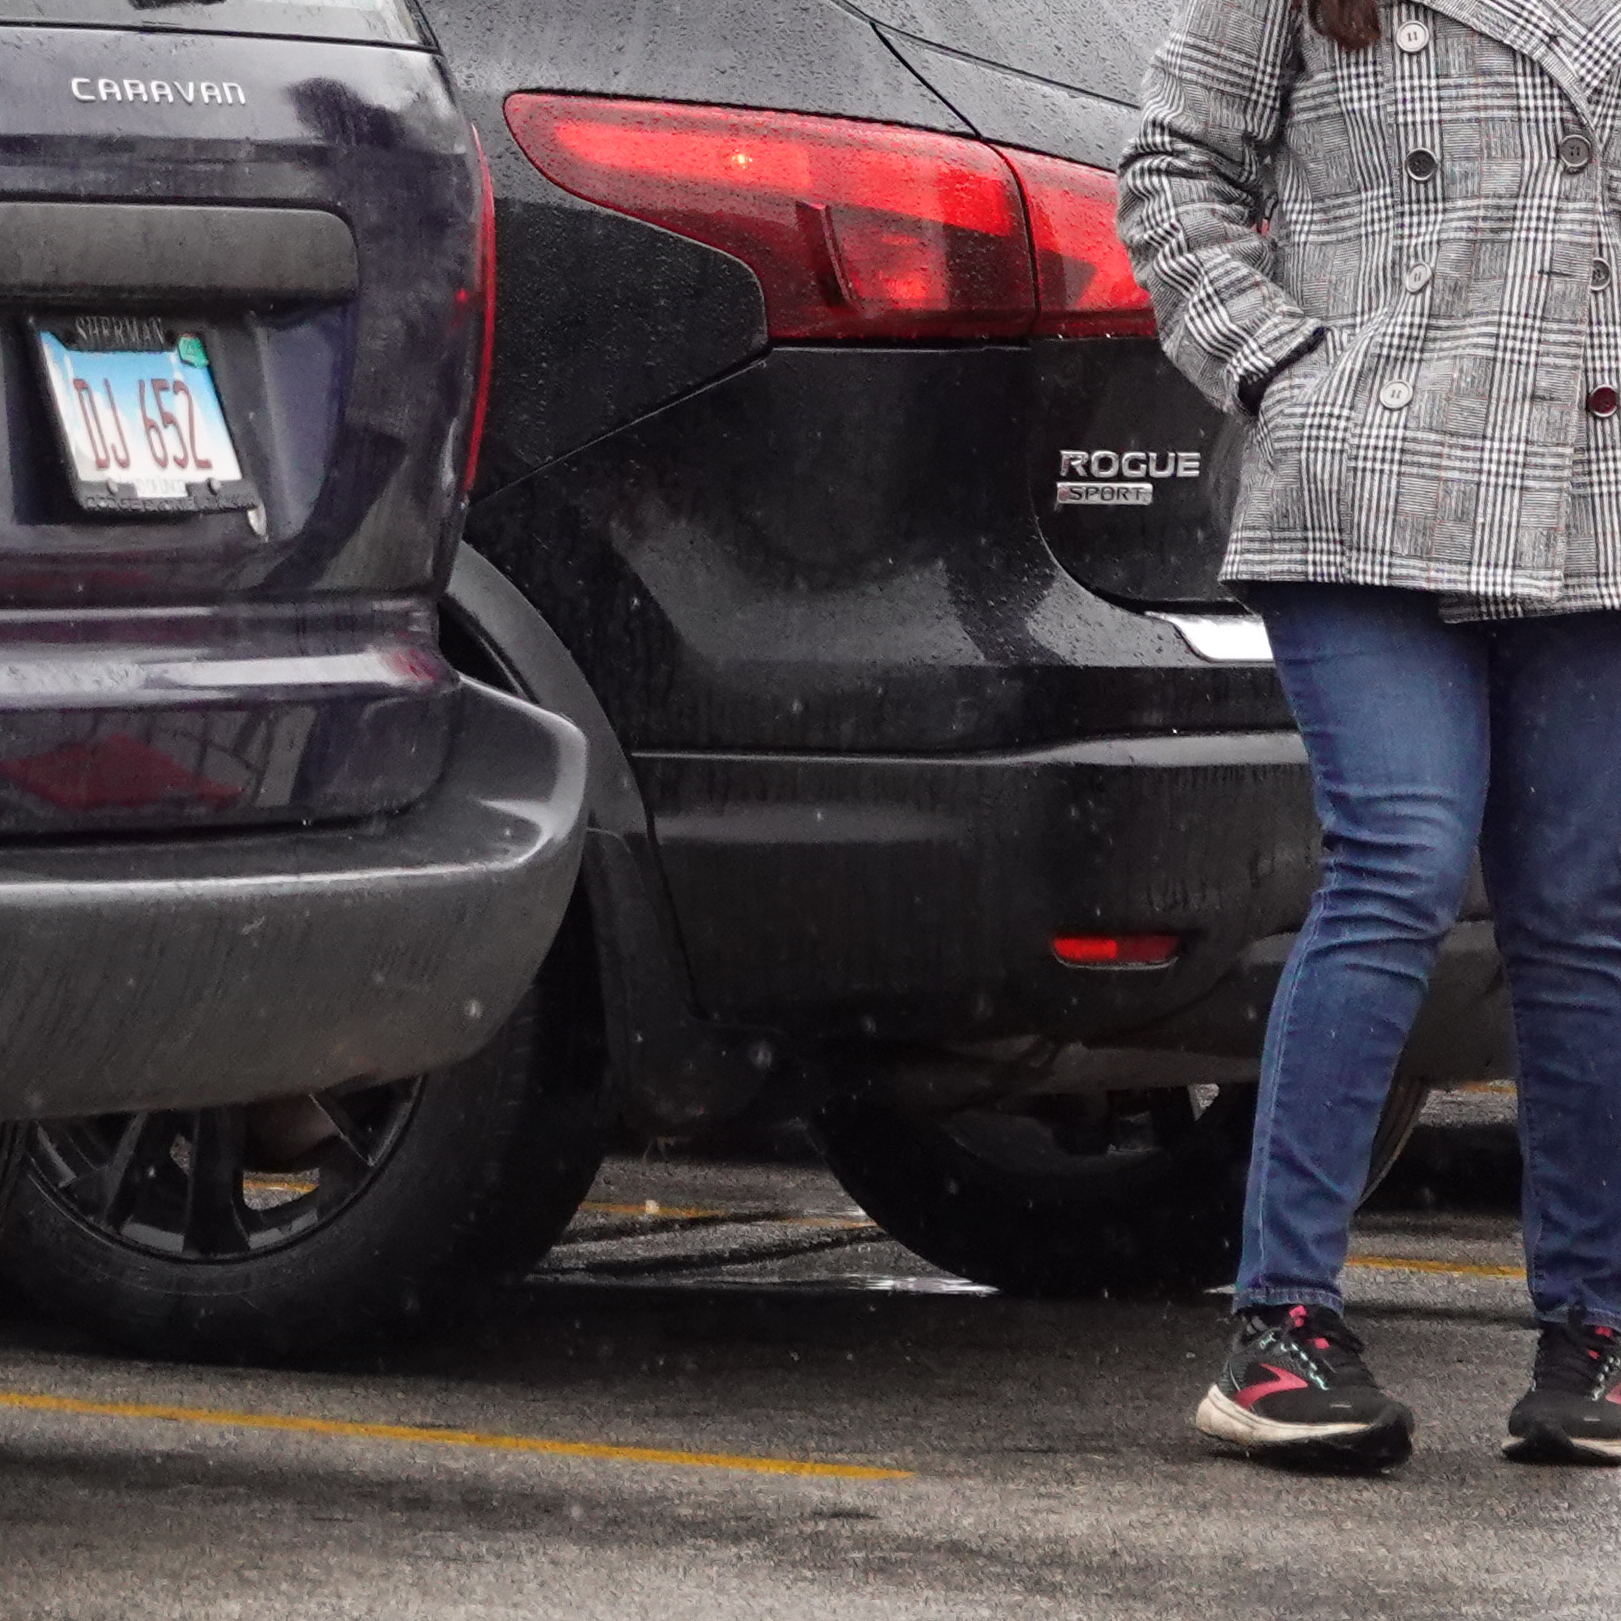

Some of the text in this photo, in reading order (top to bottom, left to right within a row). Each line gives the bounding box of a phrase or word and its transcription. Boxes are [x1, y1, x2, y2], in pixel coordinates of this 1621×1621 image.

[71, 77, 246, 105] CARAVAN
[73, 378, 212, 468] DJ 652
[1059, 450, 1201, 478] ROGUE
[1069, 486, 1144, 501] SPORT
